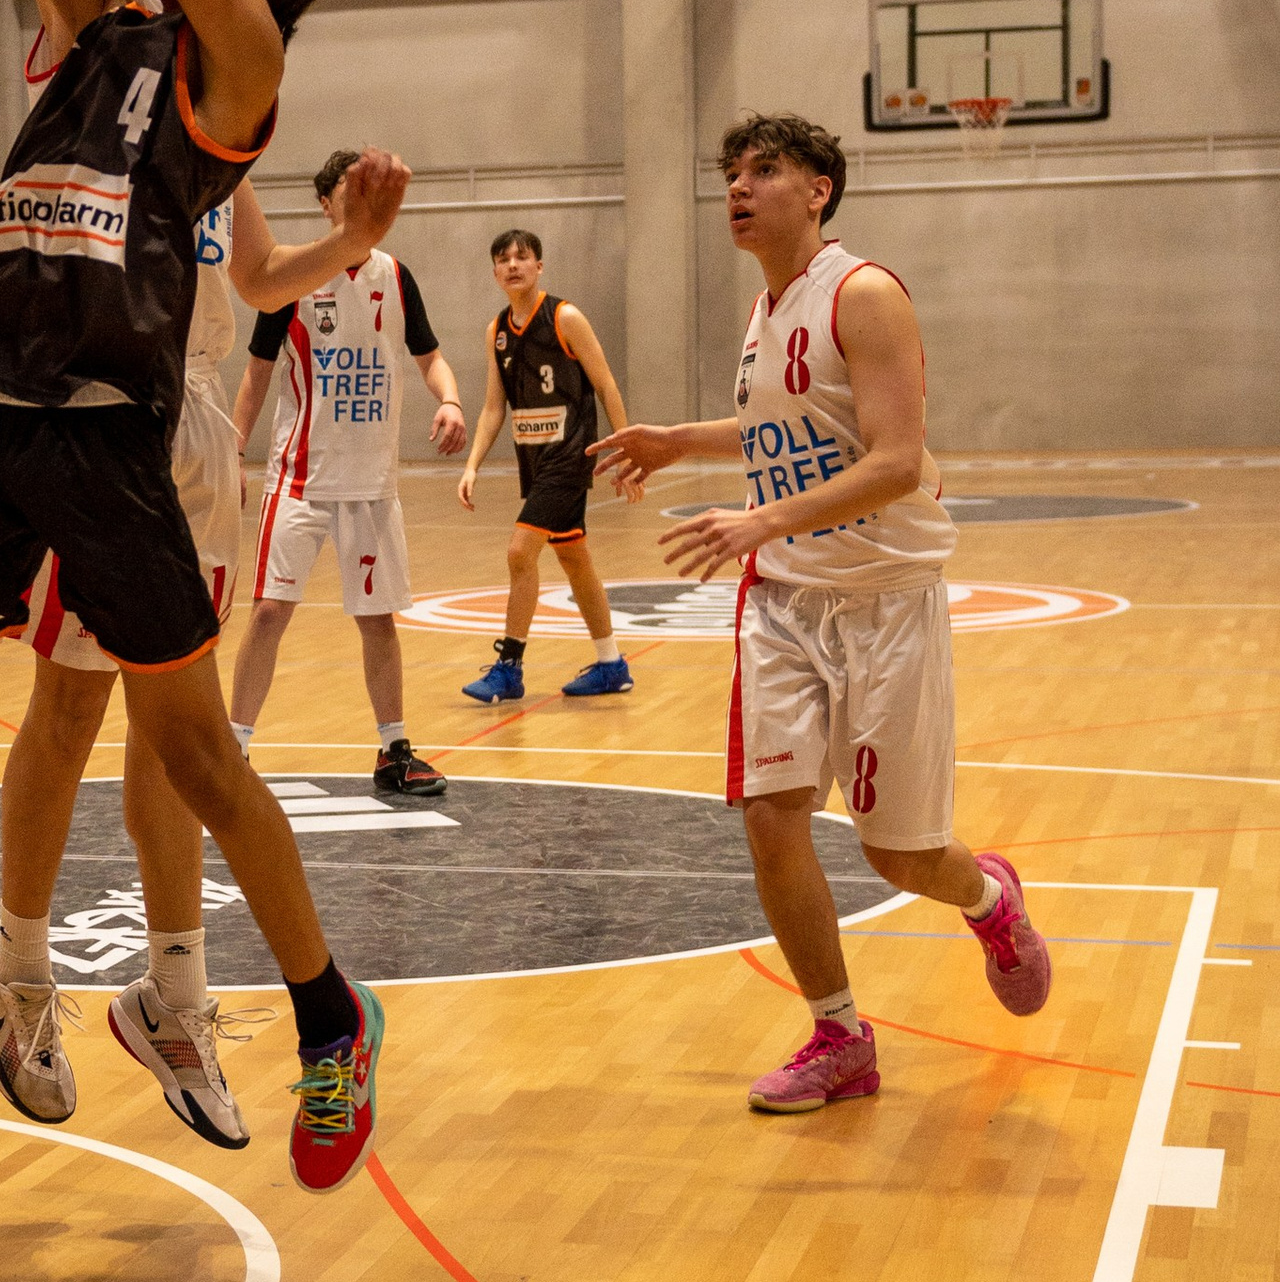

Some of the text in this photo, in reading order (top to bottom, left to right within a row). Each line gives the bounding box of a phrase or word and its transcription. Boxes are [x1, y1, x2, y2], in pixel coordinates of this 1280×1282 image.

[117, 67, 162, 145] 4
[369, 291, 384, 332] 7
[312, 346, 385, 371] VOLL
[539, 364, 555, 394] 3
[784, 327, 811, 395] 8
[317, 373, 385, 397] TREF
[334, 400, 383, 423] FER
[740, 414, 837, 464] VOLL
[359, 554, 376, 596] 7
[755, 750, 794, 768] SPALDING
[852, 745, 878, 814] 8
